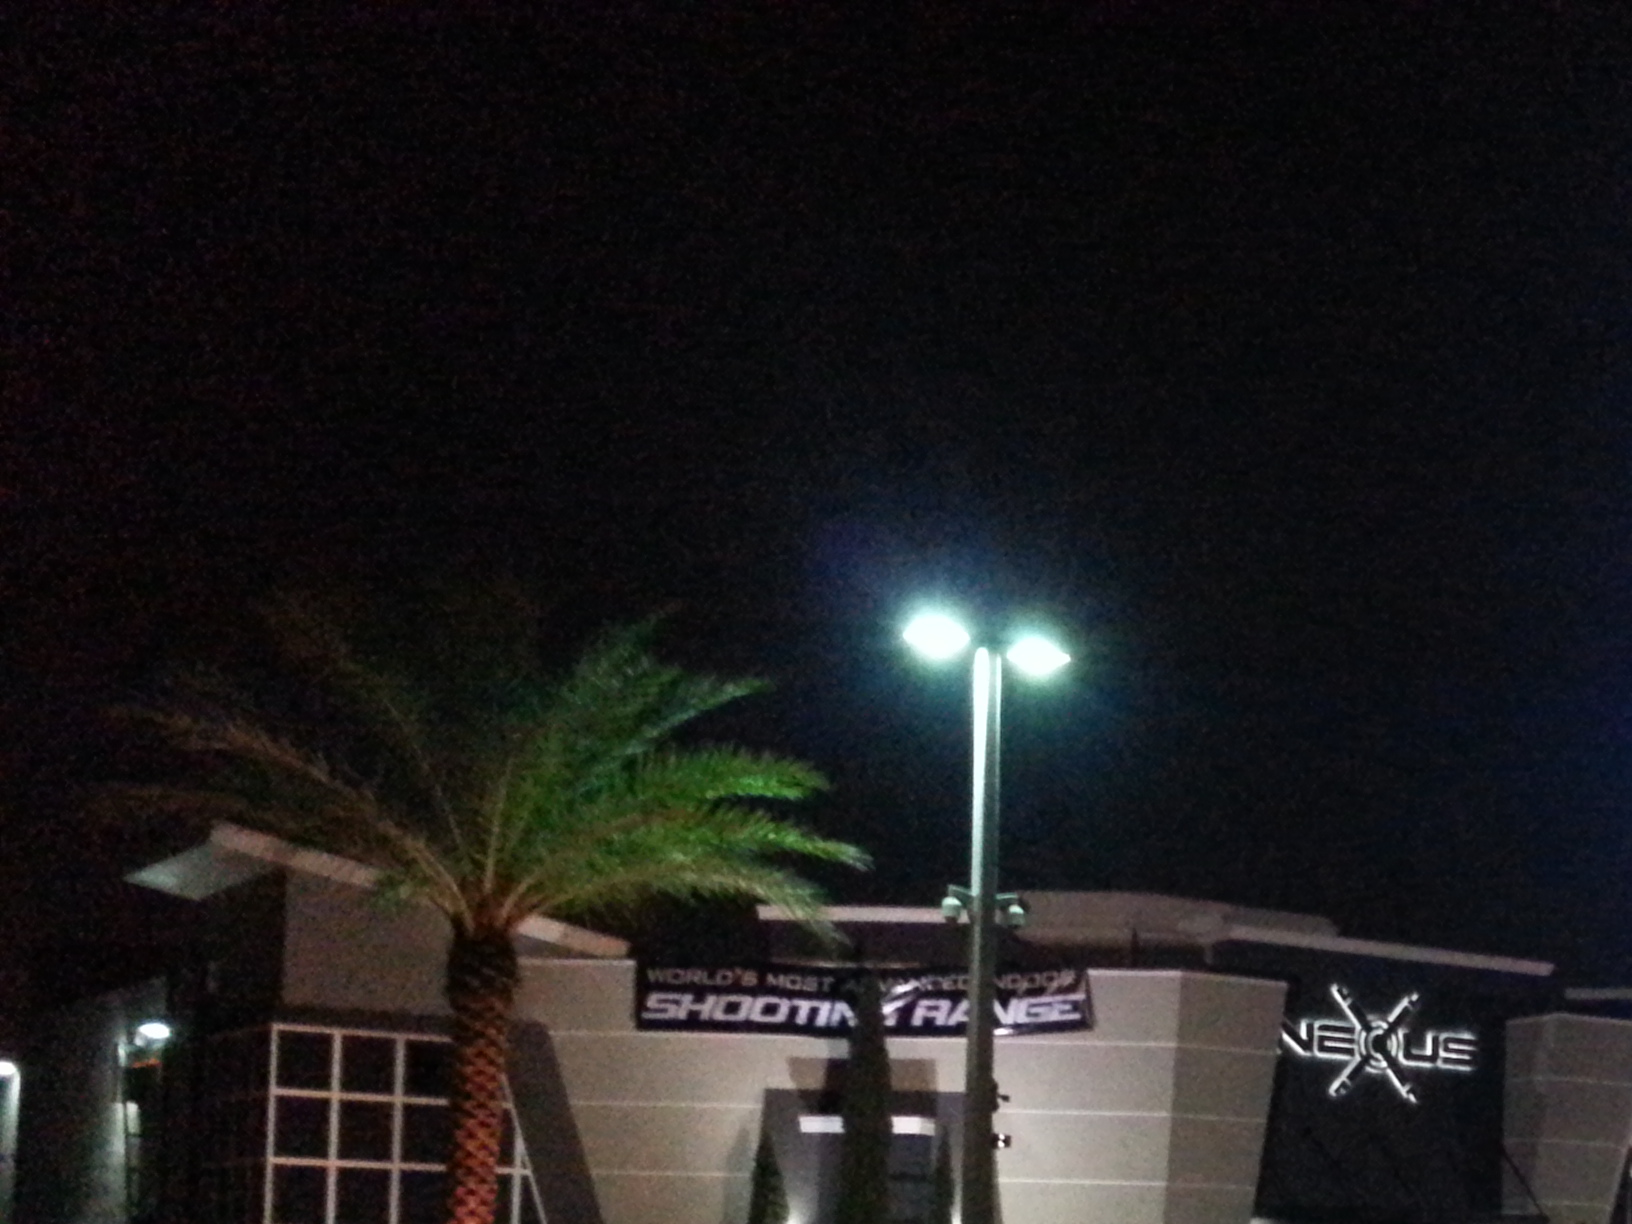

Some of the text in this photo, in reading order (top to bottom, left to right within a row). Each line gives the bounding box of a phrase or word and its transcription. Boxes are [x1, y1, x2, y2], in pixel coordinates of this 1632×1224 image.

[647, 967, 758, 987] WORLD'S
[766, 972, 835, 992] MOST
[991, 969, 1079, 989] NDOOR
[1280, 984, 1476, 1103] NEXUS
